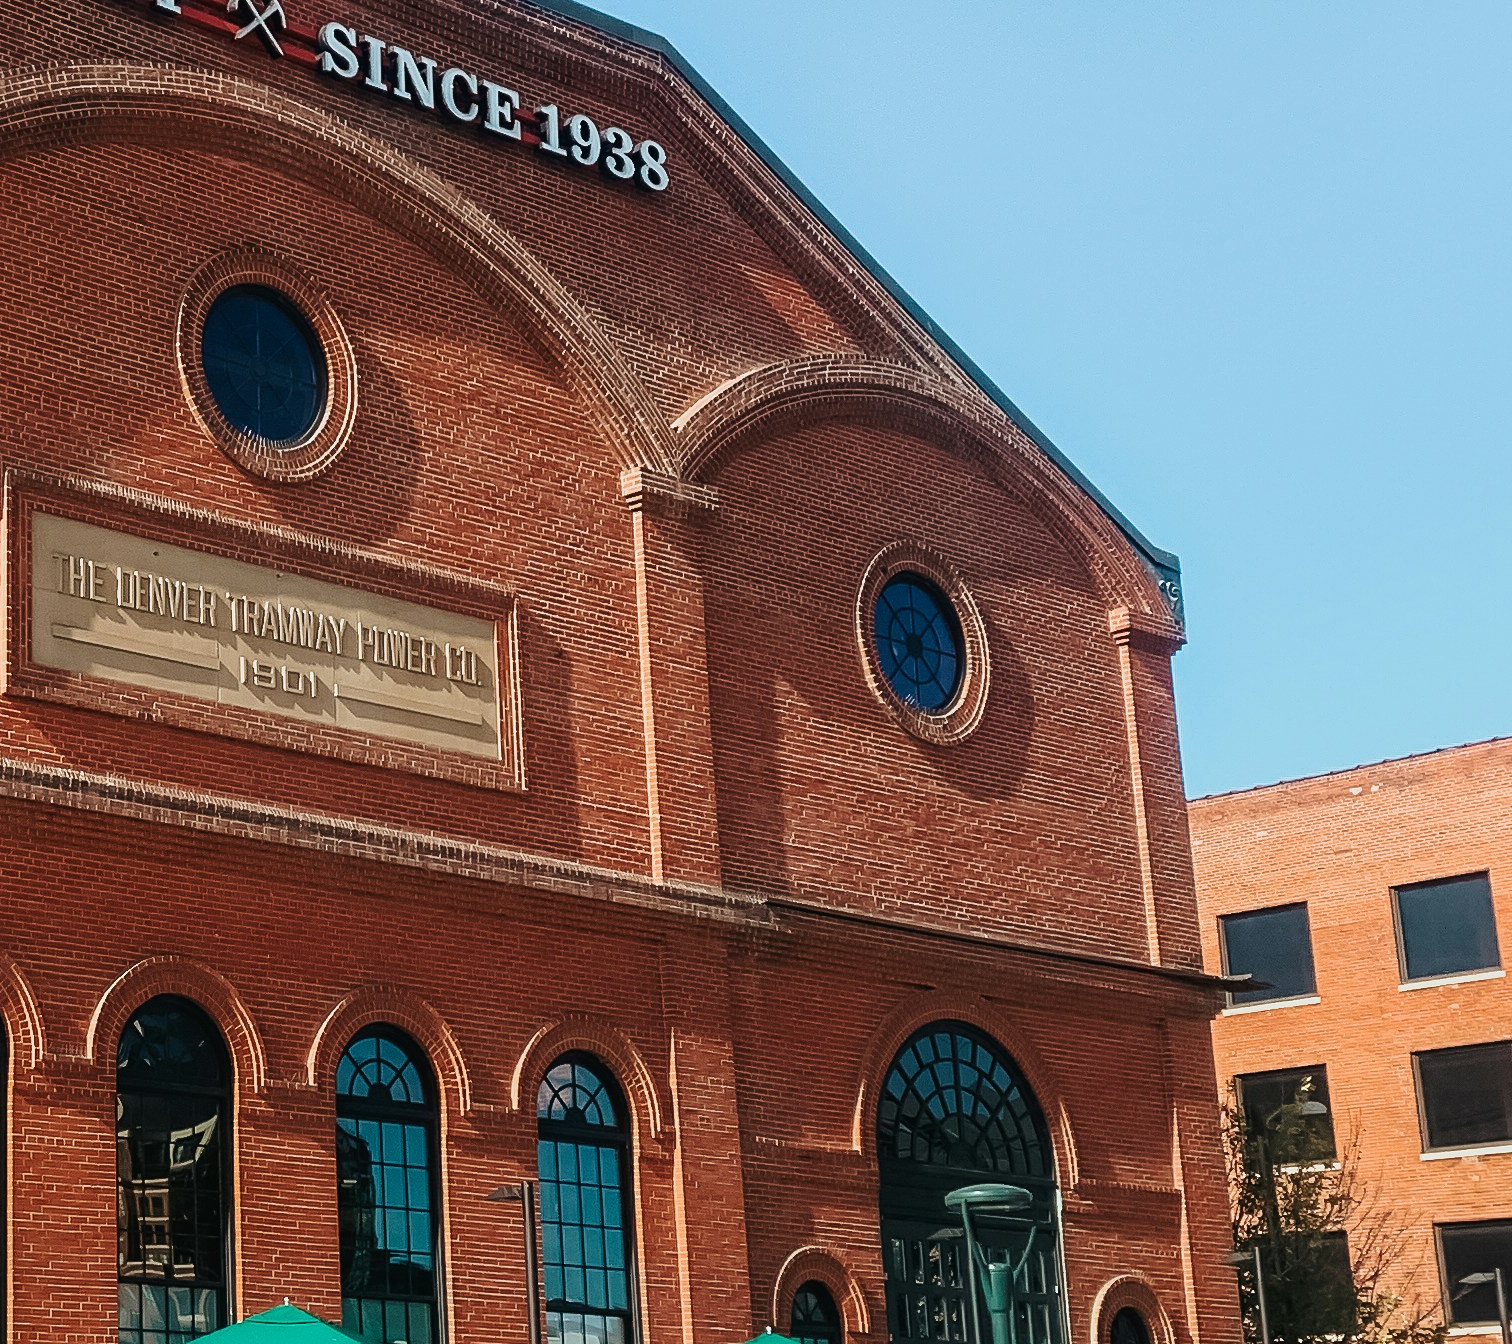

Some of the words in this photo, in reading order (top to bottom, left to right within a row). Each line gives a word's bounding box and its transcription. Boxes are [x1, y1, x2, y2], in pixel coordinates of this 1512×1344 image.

[315, 20, 522, 140] SINCE
[536, 104, 670, 192] 1938
[52, 553, 106, 603] THE
[116, 566, 216, 627] DENVER
[226, 592, 346, 655] TRAMWAY
[357, 621, 437, 677] POWER
[444, 642, 482, 686] CO.
[239, 656, 318, 698] 1901
